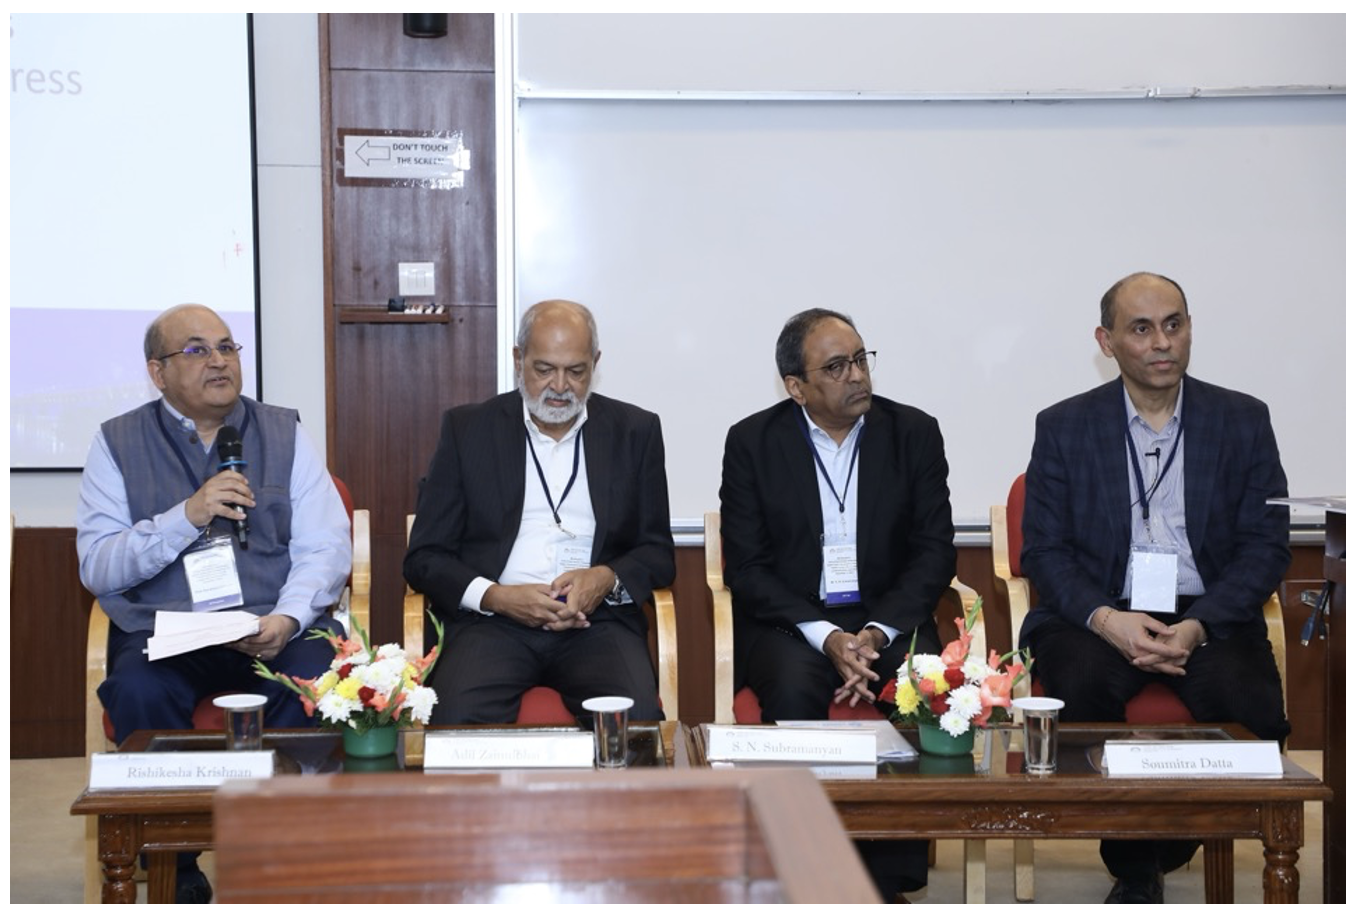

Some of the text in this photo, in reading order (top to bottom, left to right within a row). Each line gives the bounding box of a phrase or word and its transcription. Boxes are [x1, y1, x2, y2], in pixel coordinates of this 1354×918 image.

[392, 142, 449, 153] DON'T TOUCH
[396, 157, 412, 165] THE
[1140, 757, 1234, 770] Soumitra Datta
[126, 765, 252, 779] Rishikesha Krishnan
